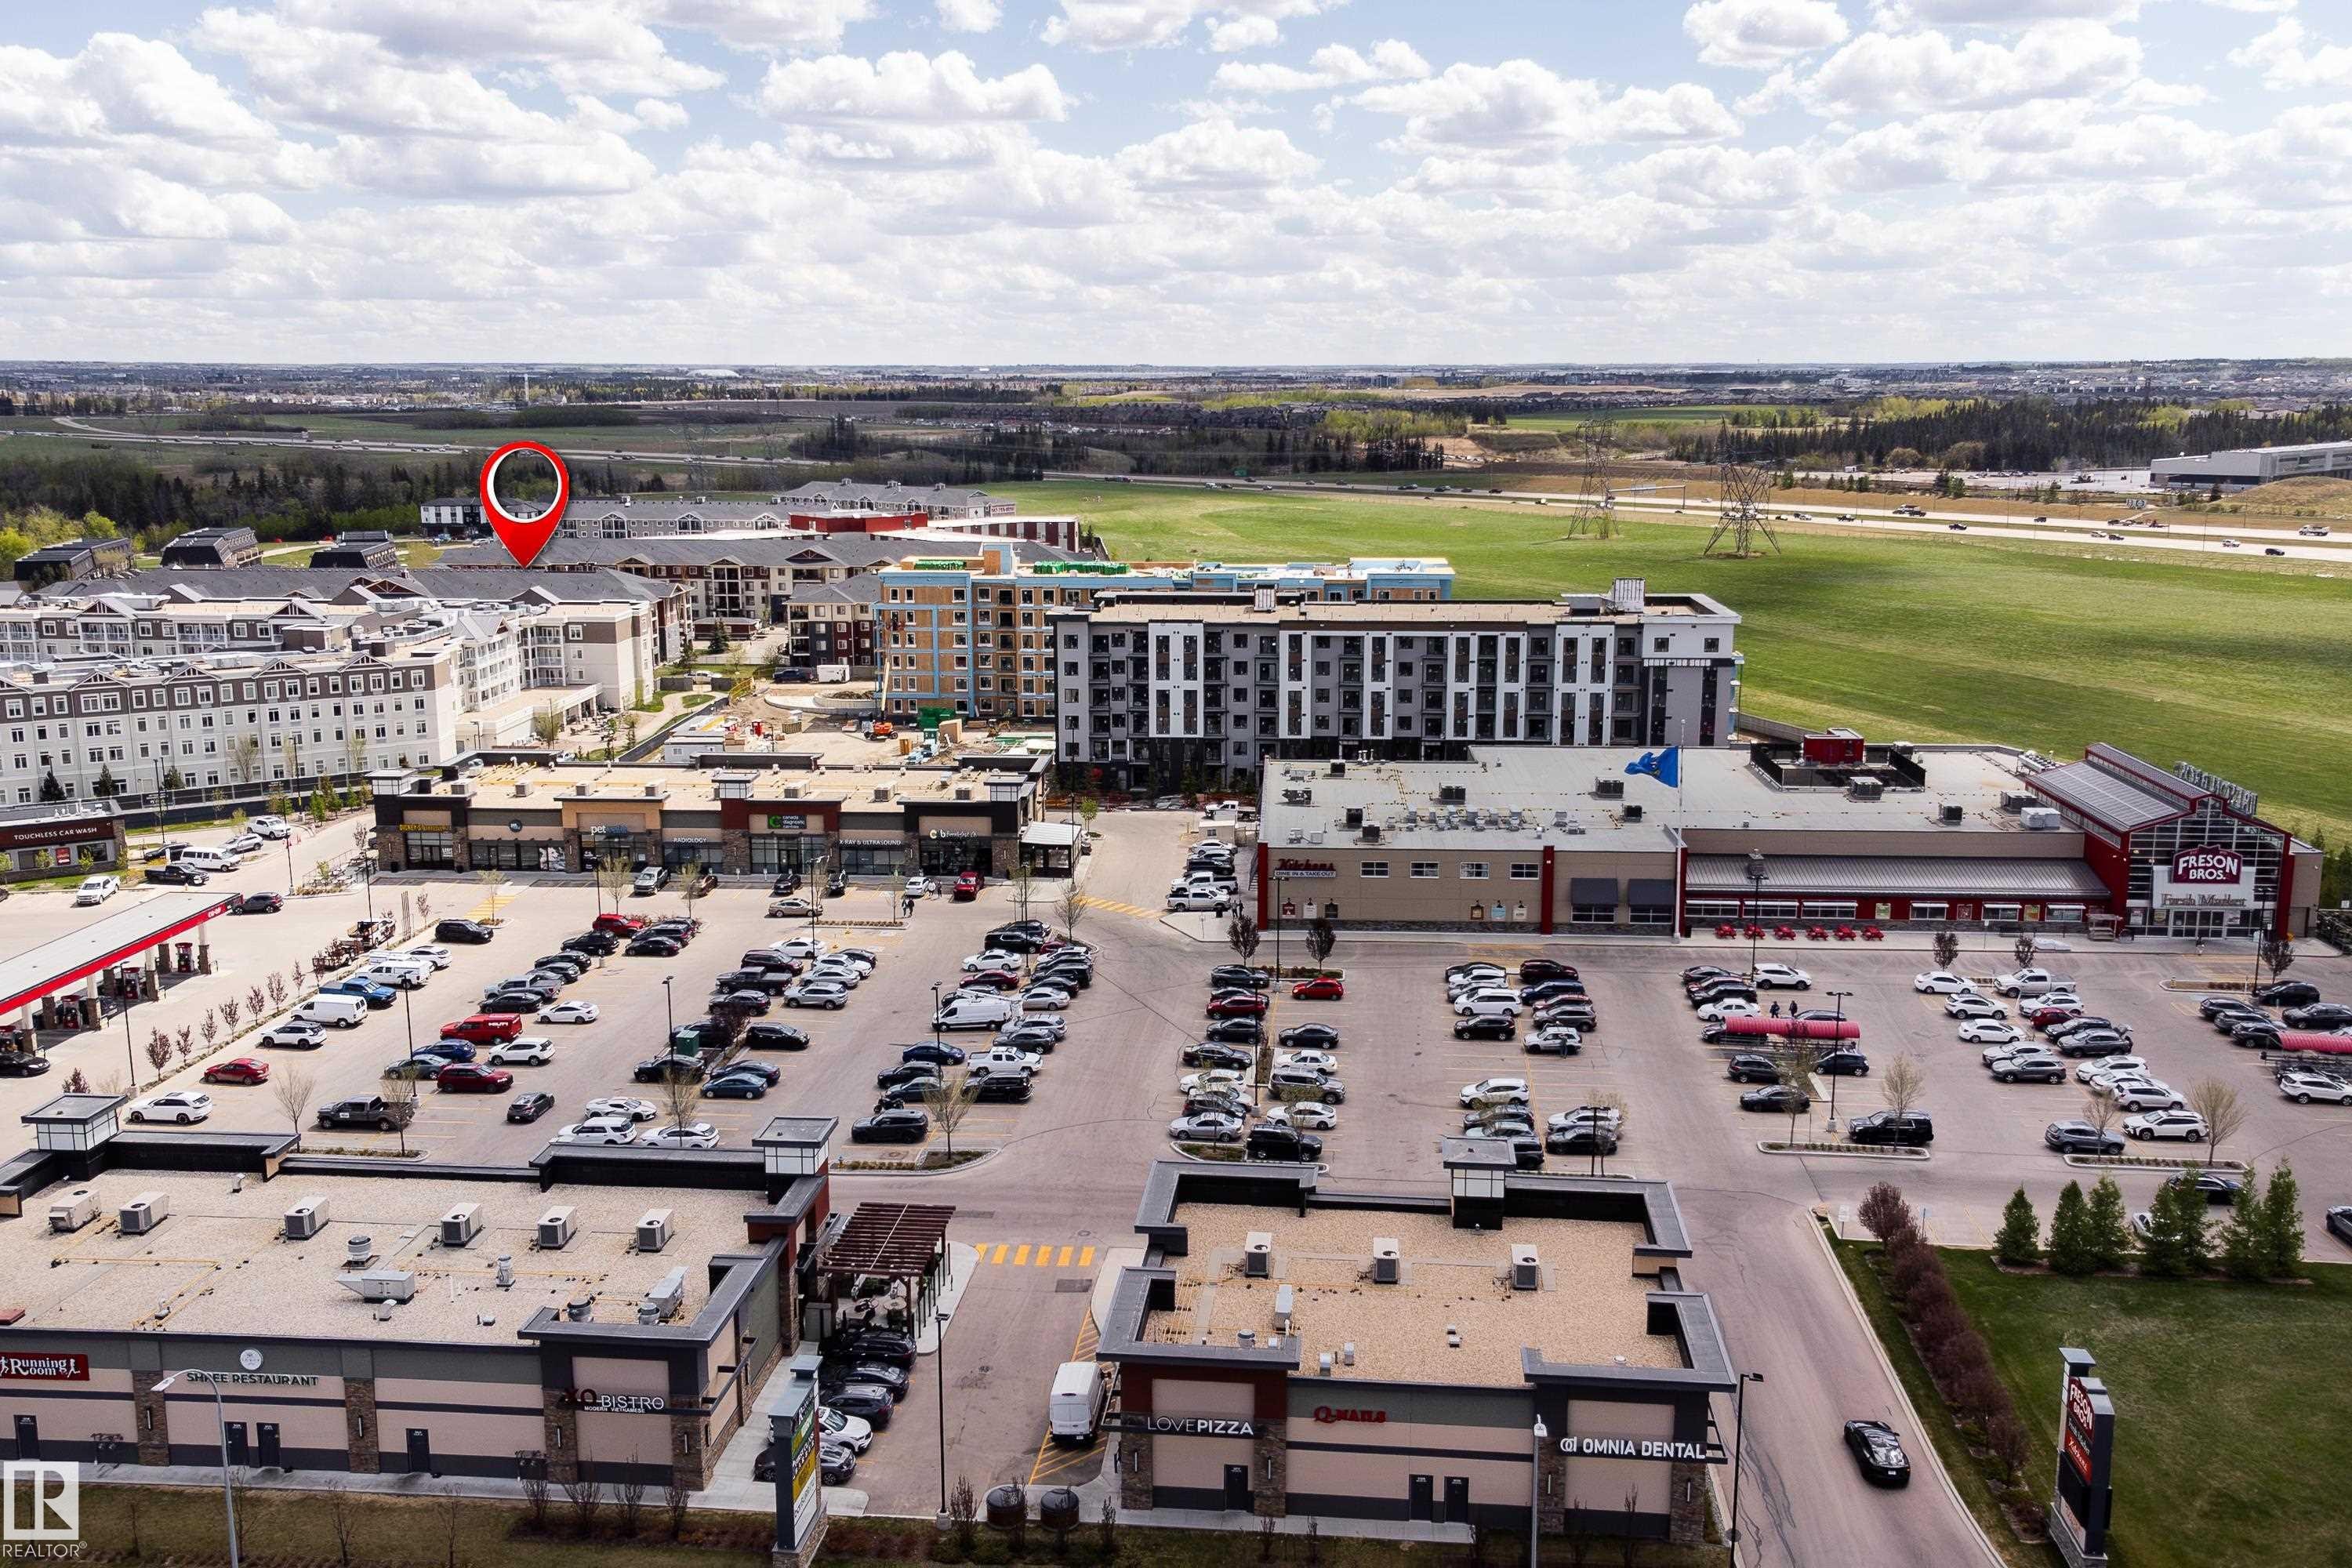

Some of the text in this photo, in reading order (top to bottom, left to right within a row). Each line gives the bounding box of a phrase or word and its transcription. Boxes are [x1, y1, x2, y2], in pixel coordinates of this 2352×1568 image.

[590, 826, 606, 835] pet
[2178, 855, 2238, 875] FRESON
[2190, 869, 2226, 879] BROS.
[9, 1358, 67, 1375] Running
[232, 1373, 318, 1386] RESTAURANT
[601, 1395, 664, 1410] BISTRO
[1583, 1438, 1635, 1456] OMNIA
[1641, 1442, 1706, 1459] DENTAL
